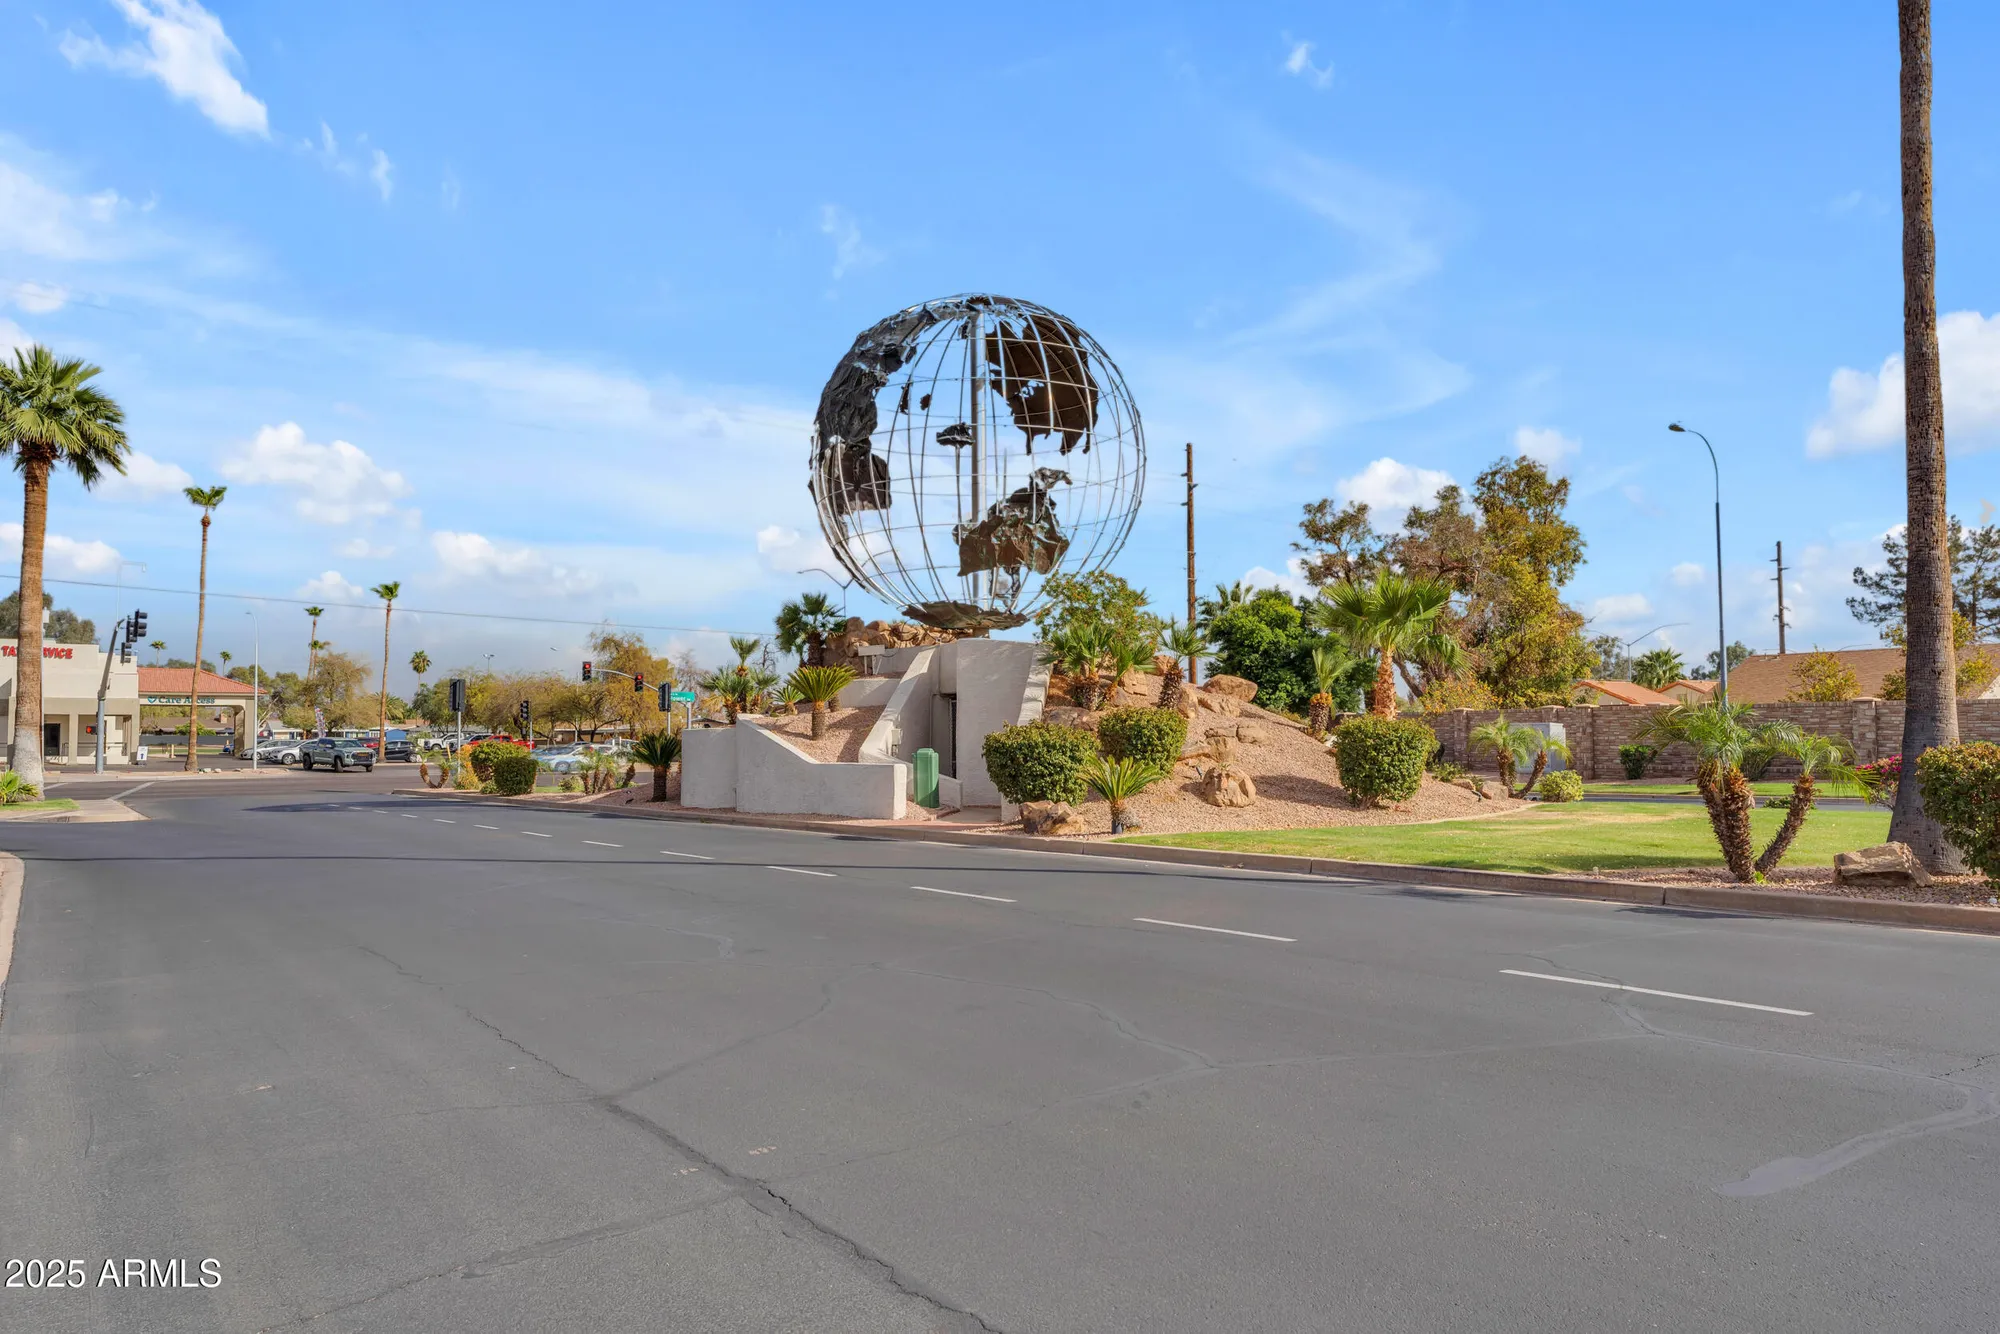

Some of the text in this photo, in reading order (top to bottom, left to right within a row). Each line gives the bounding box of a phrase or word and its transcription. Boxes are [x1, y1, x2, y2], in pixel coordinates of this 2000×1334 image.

[1, 646, 73, 659] TA RVICE
[159, 696, 215, 704] Care Acess
